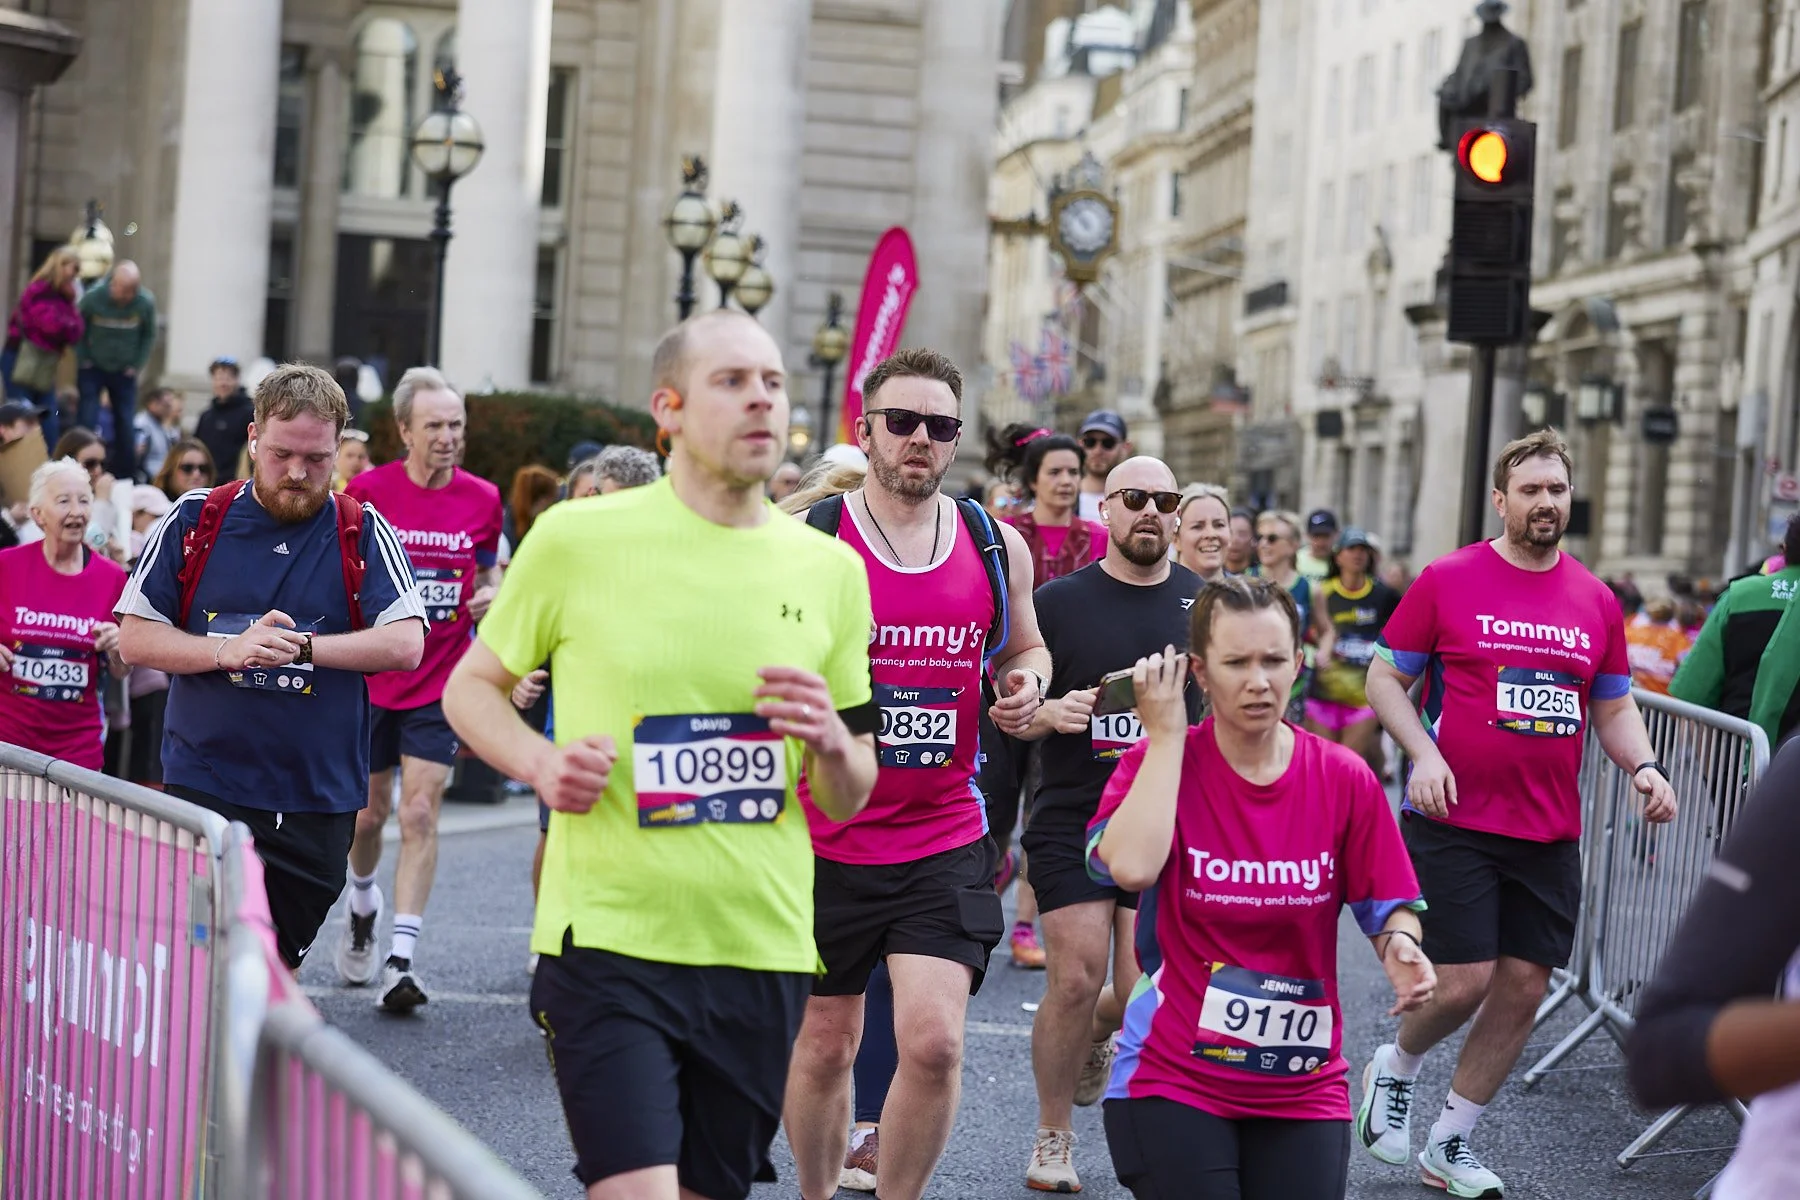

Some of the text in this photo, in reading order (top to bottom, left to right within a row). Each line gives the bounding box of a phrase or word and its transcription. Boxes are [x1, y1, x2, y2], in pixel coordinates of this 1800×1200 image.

[392, 525, 473, 551] ommy's
[419, 585, 457, 603] 434
[1771, 579, 1788, 591] St
[1476, 614, 1591, 649] Tommy's
[1493, 642, 1533, 653] pregnancy
[1550, 648, 1570, 658] baby
[1570, 652, 1591, 665] charity
[20, 660, 83, 683] 10433
[907, 658, 927, 666] and
[929, 658, 951, 668] baby
[953, 659, 973, 669] charity
[1535, 671, 1555, 681] BULL
[893, 690, 920, 701] MATT
[1505, 687, 1575, 715] 10255
[690, 717, 732, 732] DAVID
[648, 746, 775, 785] 10899
[1185, 888, 1203, 900] The
[1204, 892, 1262, 907] pregnancy
[1263, 895, 1285, 906] and
[1287, 895, 1313, 907] baby
[1260, 979, 1305, 996] JENNIE
[1224, 998, 1318, 1042] 9110
